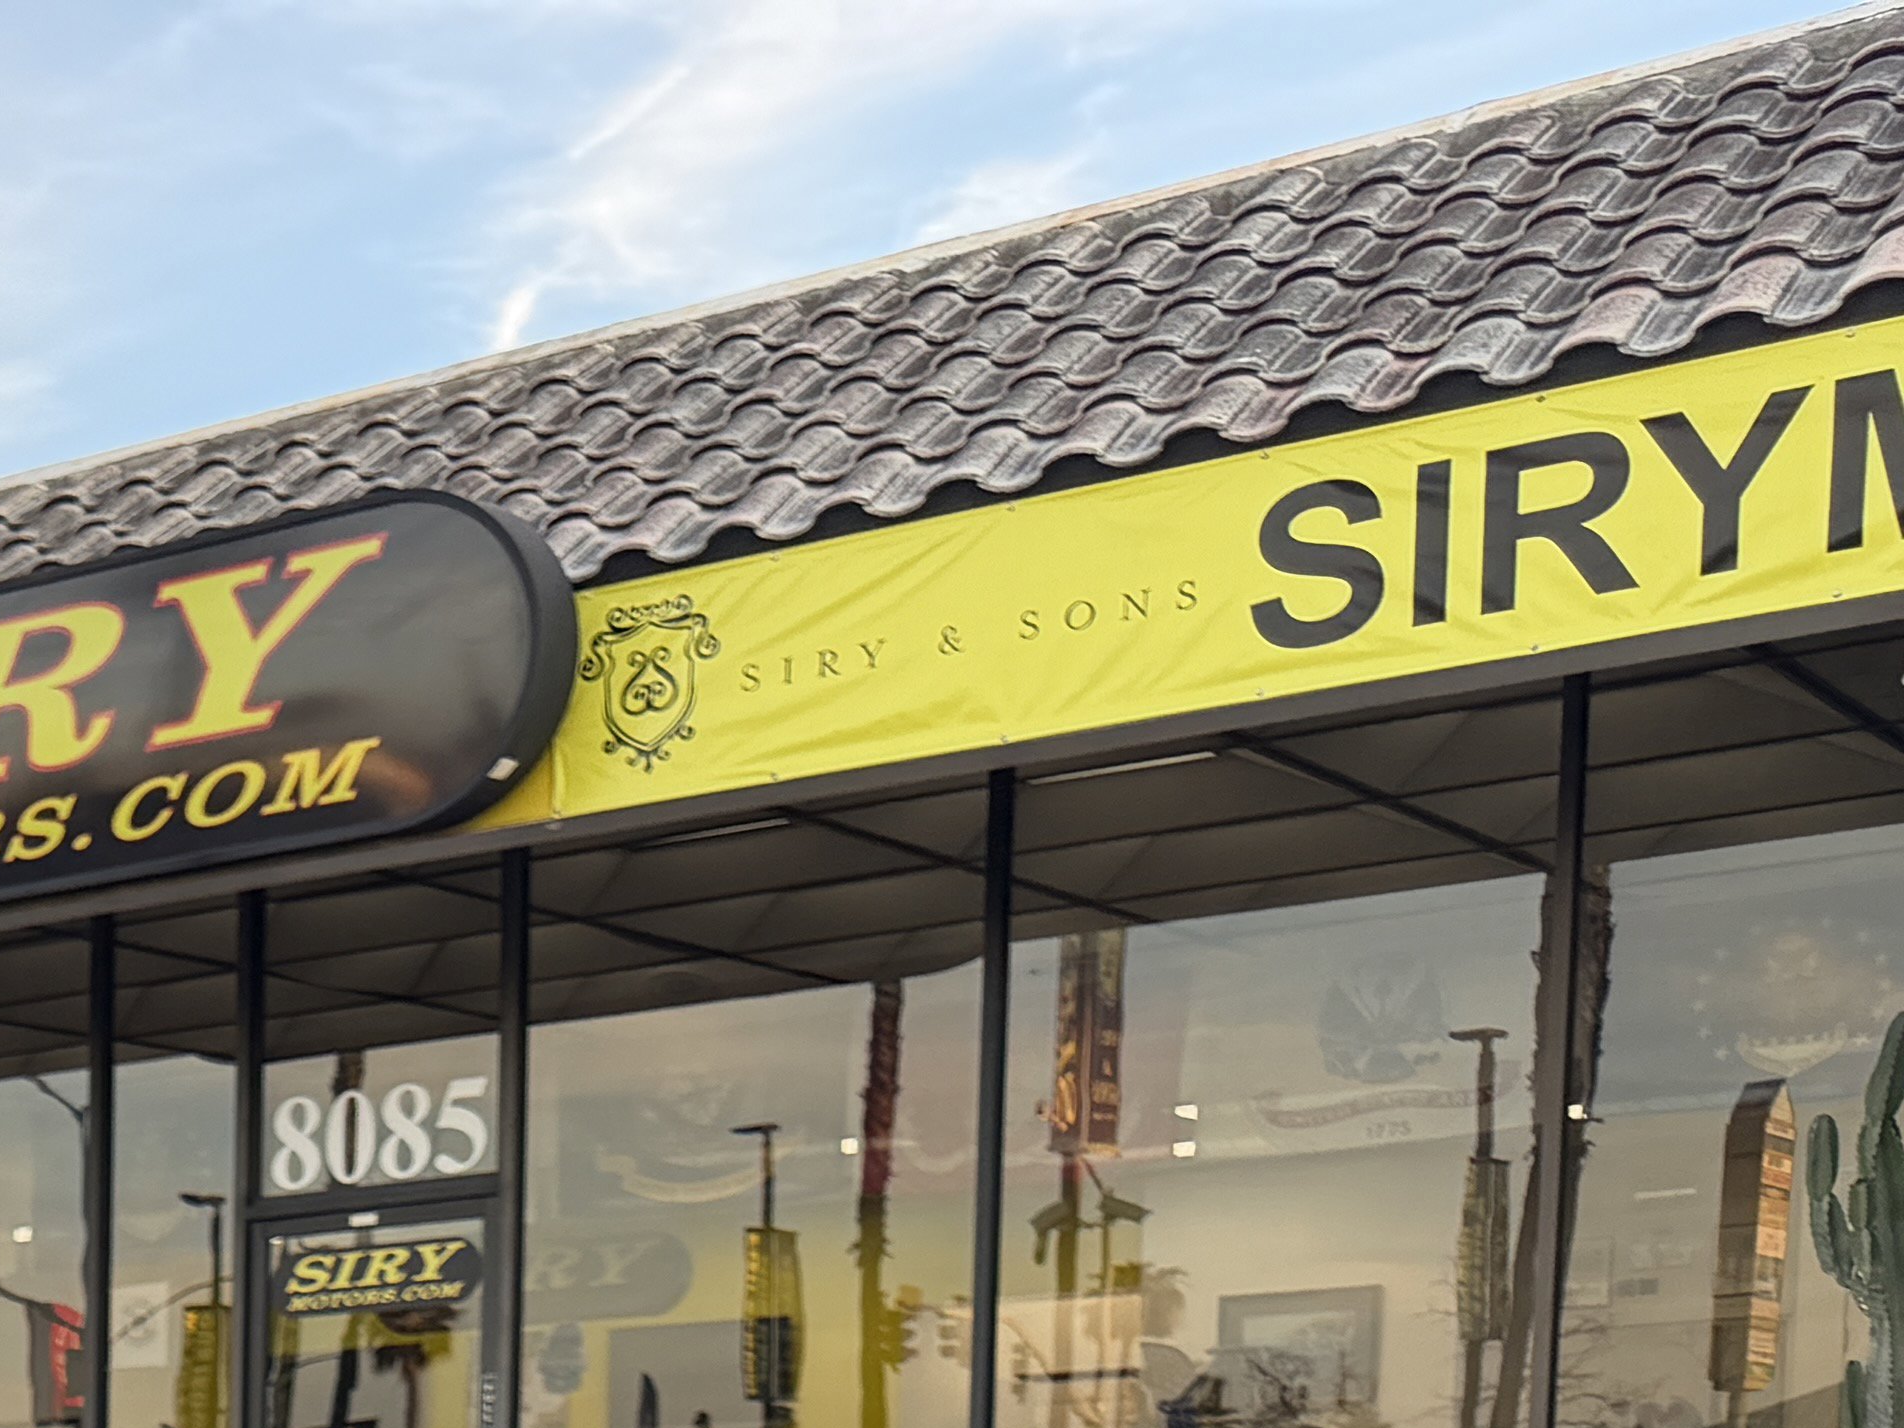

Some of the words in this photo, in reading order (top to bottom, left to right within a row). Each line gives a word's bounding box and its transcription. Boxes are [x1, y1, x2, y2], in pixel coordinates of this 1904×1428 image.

[738, 636, 886, 694] SIRY
[936, 622, 966, 656] &
[1016, 578, 1202, 642] SONS
[271, 1077, 488, 1191] 8085
[284, 1239, 468, 1294] SIRY
